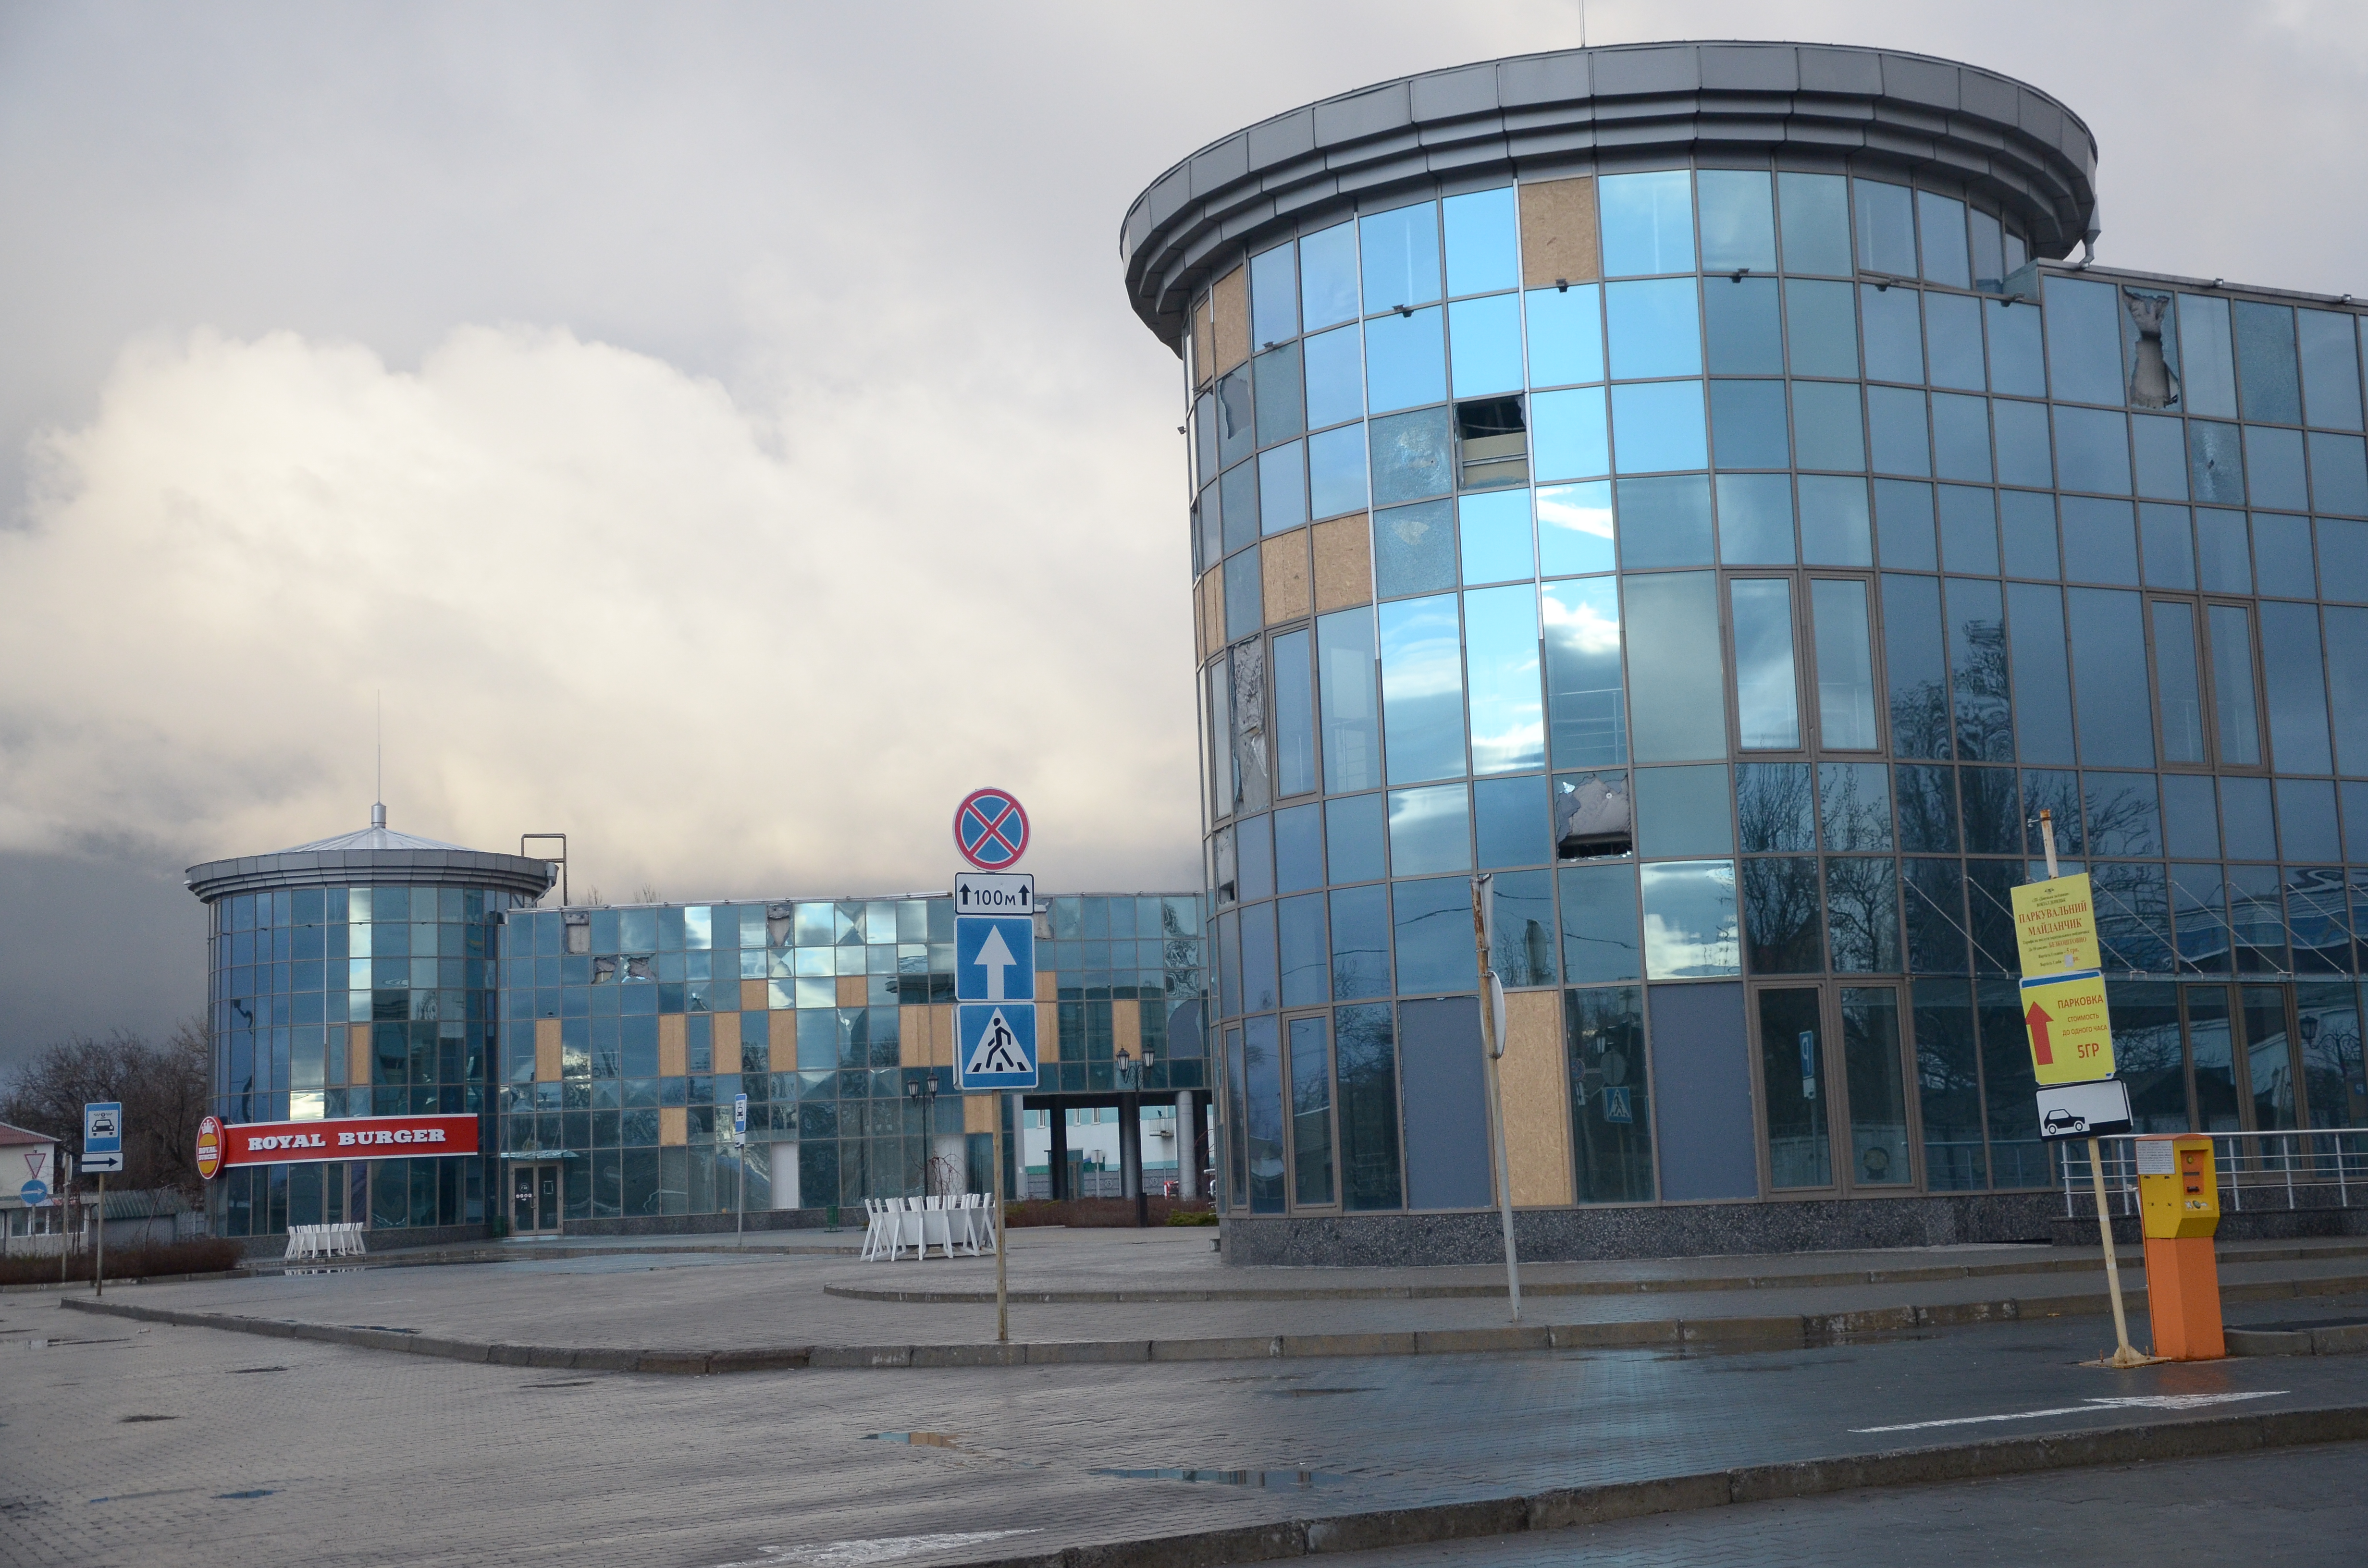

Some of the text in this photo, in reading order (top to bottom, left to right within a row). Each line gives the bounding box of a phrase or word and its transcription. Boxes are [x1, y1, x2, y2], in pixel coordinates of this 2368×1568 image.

[2019, 900, 2087, 923] ПАРКУВАЛЬНИЙ
[2028, 918, 2082, 936] МАЙДАНЧИК
[2048, 936, 2087, 947] БЕЗКОШТОВНО
[2058, 994, 2104, 1009] ПАРКОВКА
[2067, 1013, 2099, 1023] СТОИМОСТЬ
[2071, 1027, 2093, 1035] ОДНОГО
[2094, 1024, 2108, 1032] ЧАСА
[2077, 1043, 2099, 1058] 5ГР
[248, 1129, 446, 1151] ROYAL BURGER
